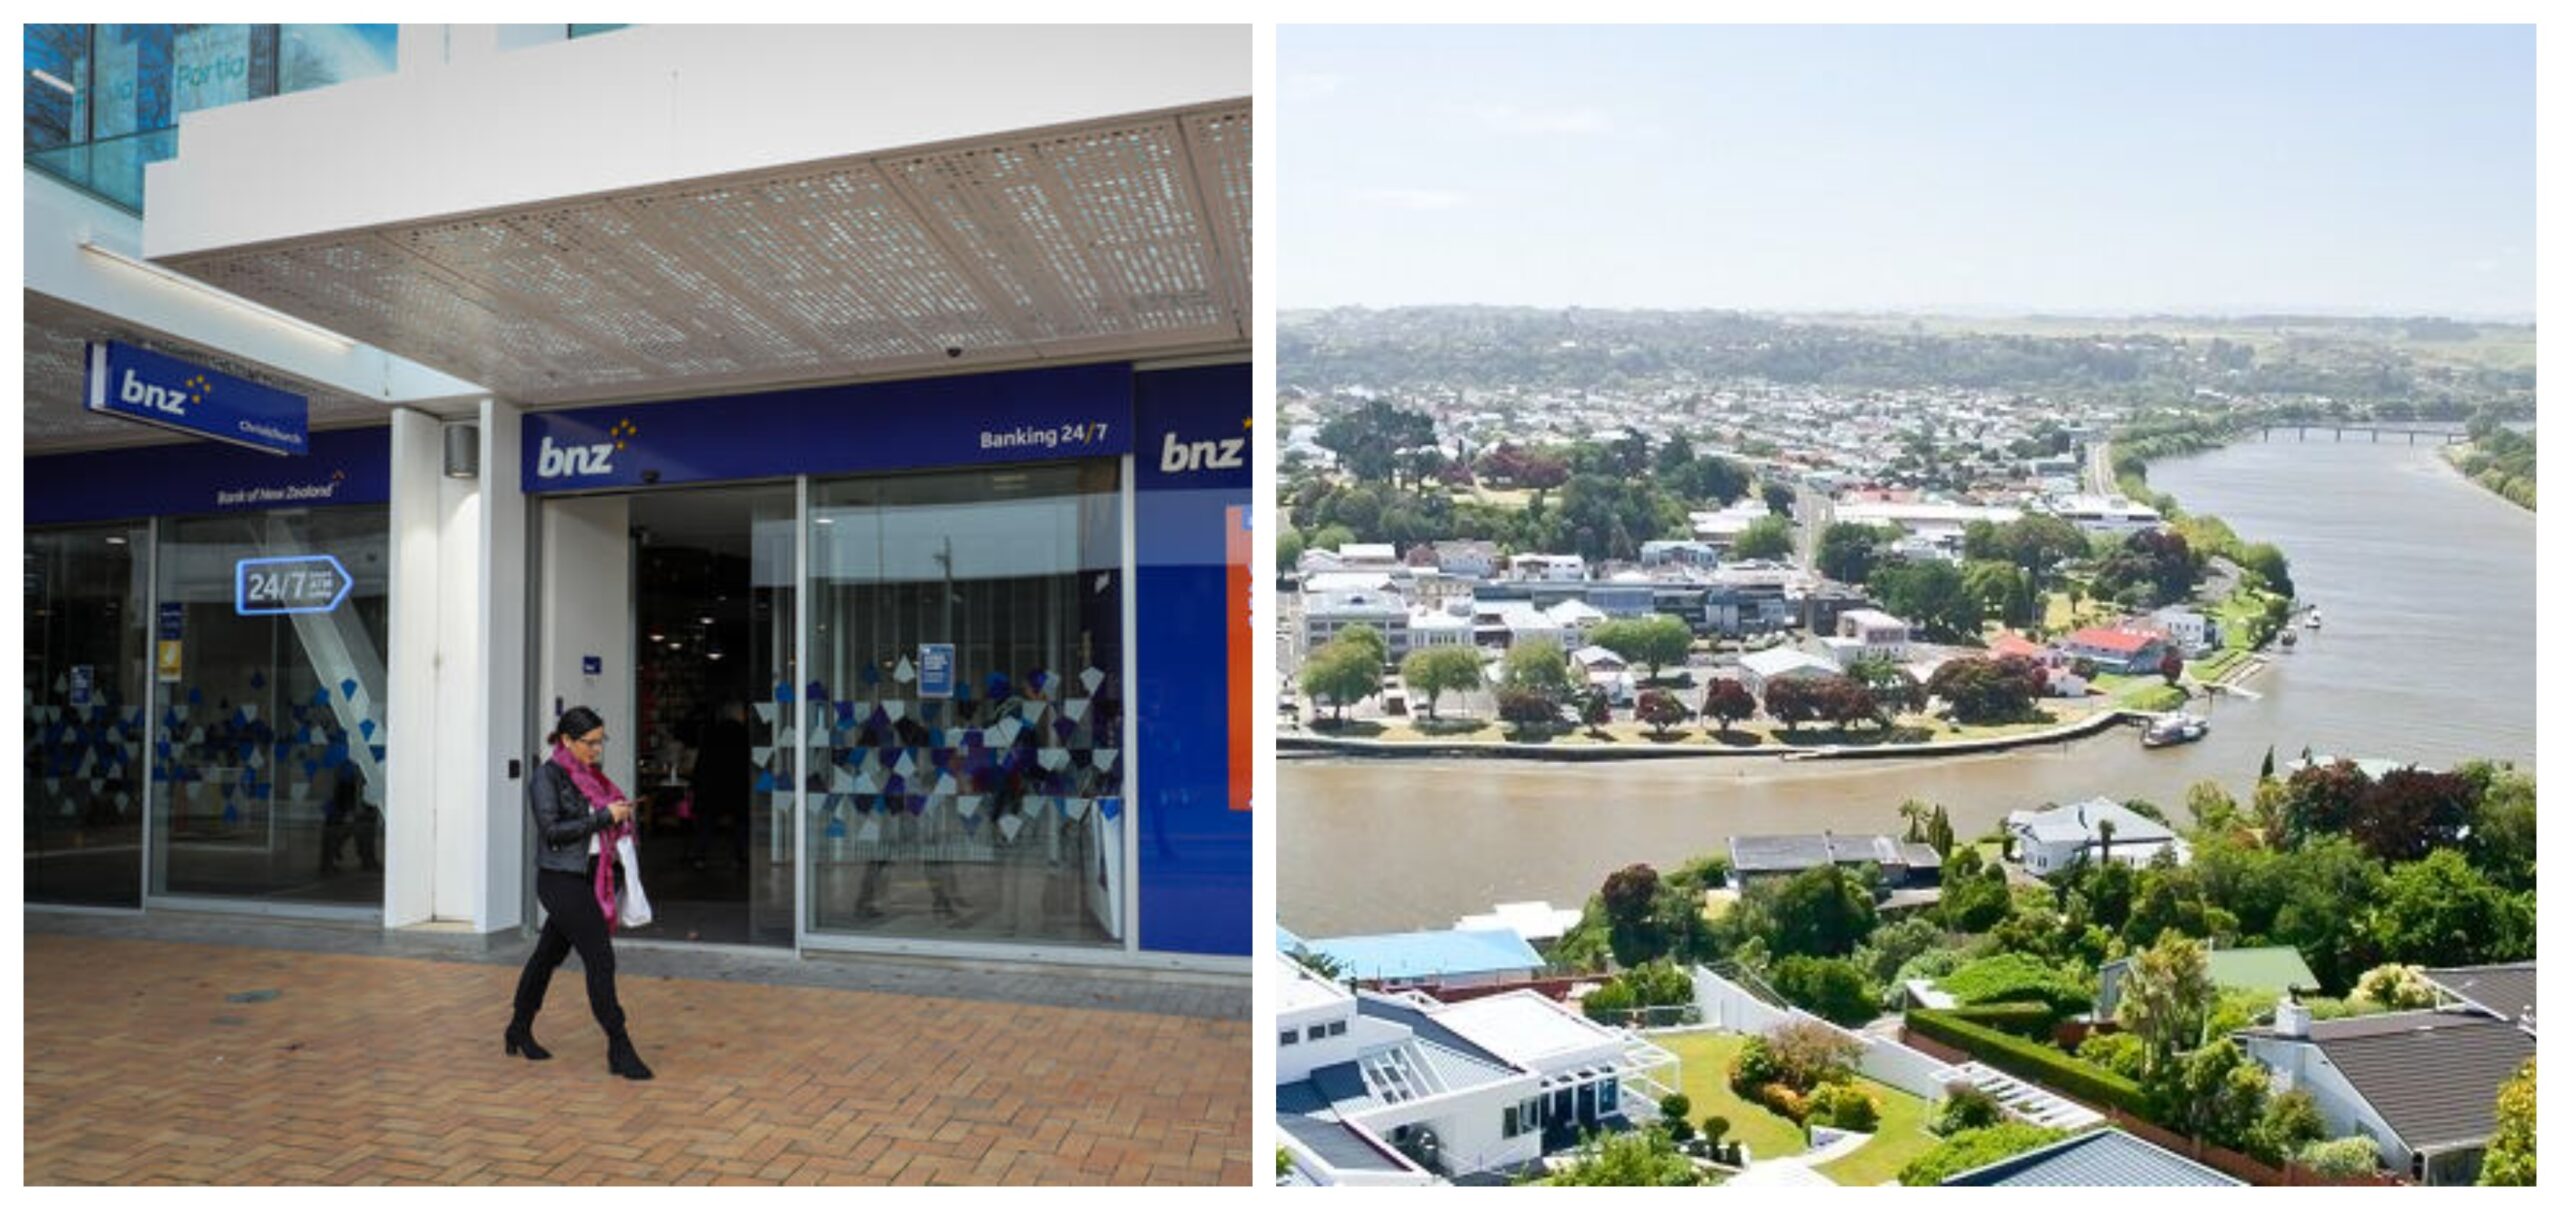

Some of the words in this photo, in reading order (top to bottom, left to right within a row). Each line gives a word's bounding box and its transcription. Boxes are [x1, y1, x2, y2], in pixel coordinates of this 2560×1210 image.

[121, 368, 185, 415] bnz
[980, 427, 1058, 449] Banking
[1061, 421, 1108, 443] 24/7
[1161, 432, 1245, 472] bnz
[537, 437, 614, 477] bnz
[217, 489, 245, 505] Bank
[247, 487, 259, 502] of
[260, 486, 285, 500] New
[286, 482, 333, 500] Zealand
[250, 572, 306, 600] 24/7
